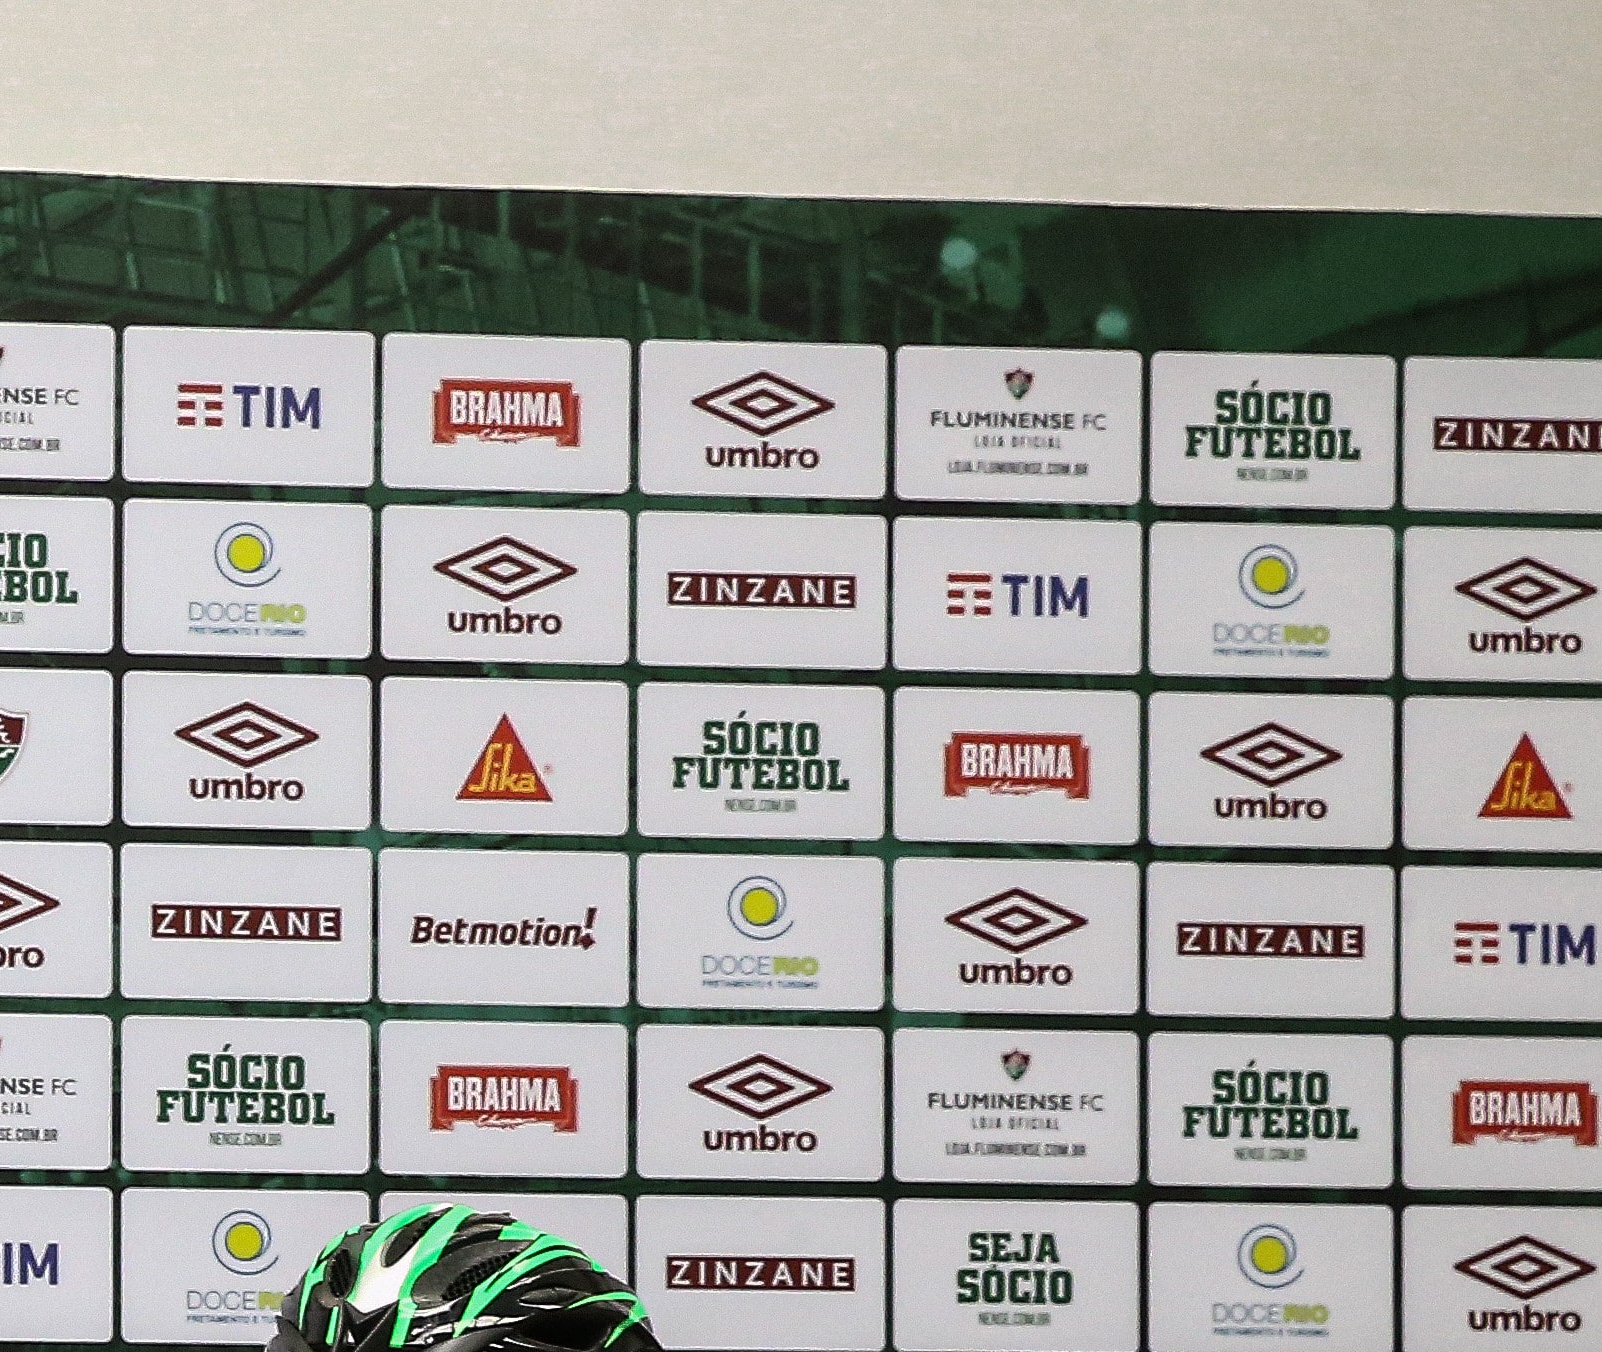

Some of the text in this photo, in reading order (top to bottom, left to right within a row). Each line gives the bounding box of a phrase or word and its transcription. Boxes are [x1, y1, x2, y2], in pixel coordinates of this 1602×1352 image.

[54, 389, 79, 405] FC
[234, 386, 320, 428] TIM
[451, 390, 563, 427] BRAHMA
[1214, 379, 1333, 428] SÓCIO
[1185, 425, 1361, 462] FUTEBOL
[1438, 422, 1602, 449] ZINZAN
[705, 441, 820, 470] umbro
[673, 577, 850, 604] ZINZANE
[1003, 575, 1087, 616] TIM
[1468, 626, 1583, 655] umbro
[410, 907, 597, 950] Betmotion!
[1183, 928, 1357, 953] ZINZANE
[186, 1044, 306, 1090] SÓCIO
[53, 1074, 78, 1097] FC
[156, 1090, 335, 1126] FUTEBOL
[968, 1232, 1061, 1264] SEJA
[672, 1261, 849, 1286] ZINZANE
[956, 1264, 1074, 1306] SÓCIO
